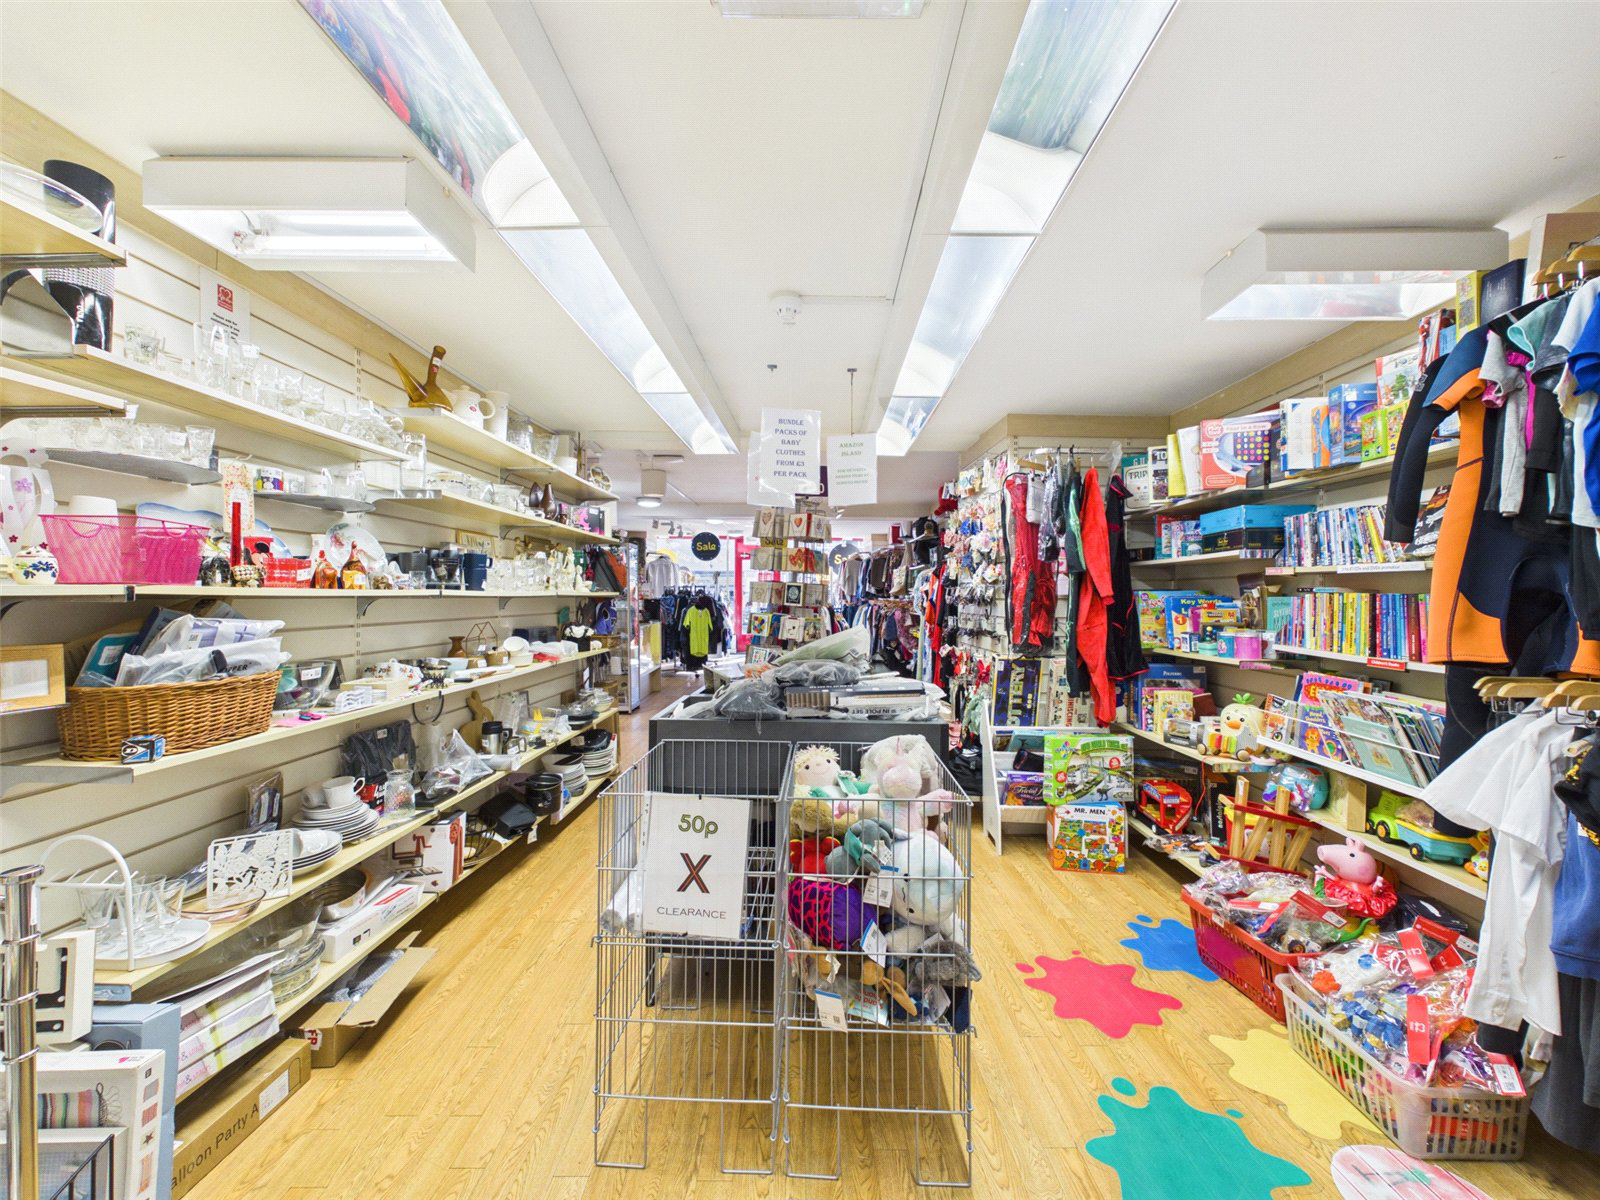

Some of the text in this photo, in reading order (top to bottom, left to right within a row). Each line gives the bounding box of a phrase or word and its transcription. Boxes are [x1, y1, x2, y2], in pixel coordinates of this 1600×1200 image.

[774, 428, 797, 436] PACKS
[778, 418, 804, 426] BUNDLE
[696, 542, 716, 551] Sale
[1006, 662, 1025, 726] OTTERY
[1066, 698, 1074, 726] INISCING
[678, 813, 719, 839] 50p
[656, 906, 727, 920] CLEARANCE
[171, 1146, 212, 1190] alloon
[216, 1113, 248, 1150] Party
